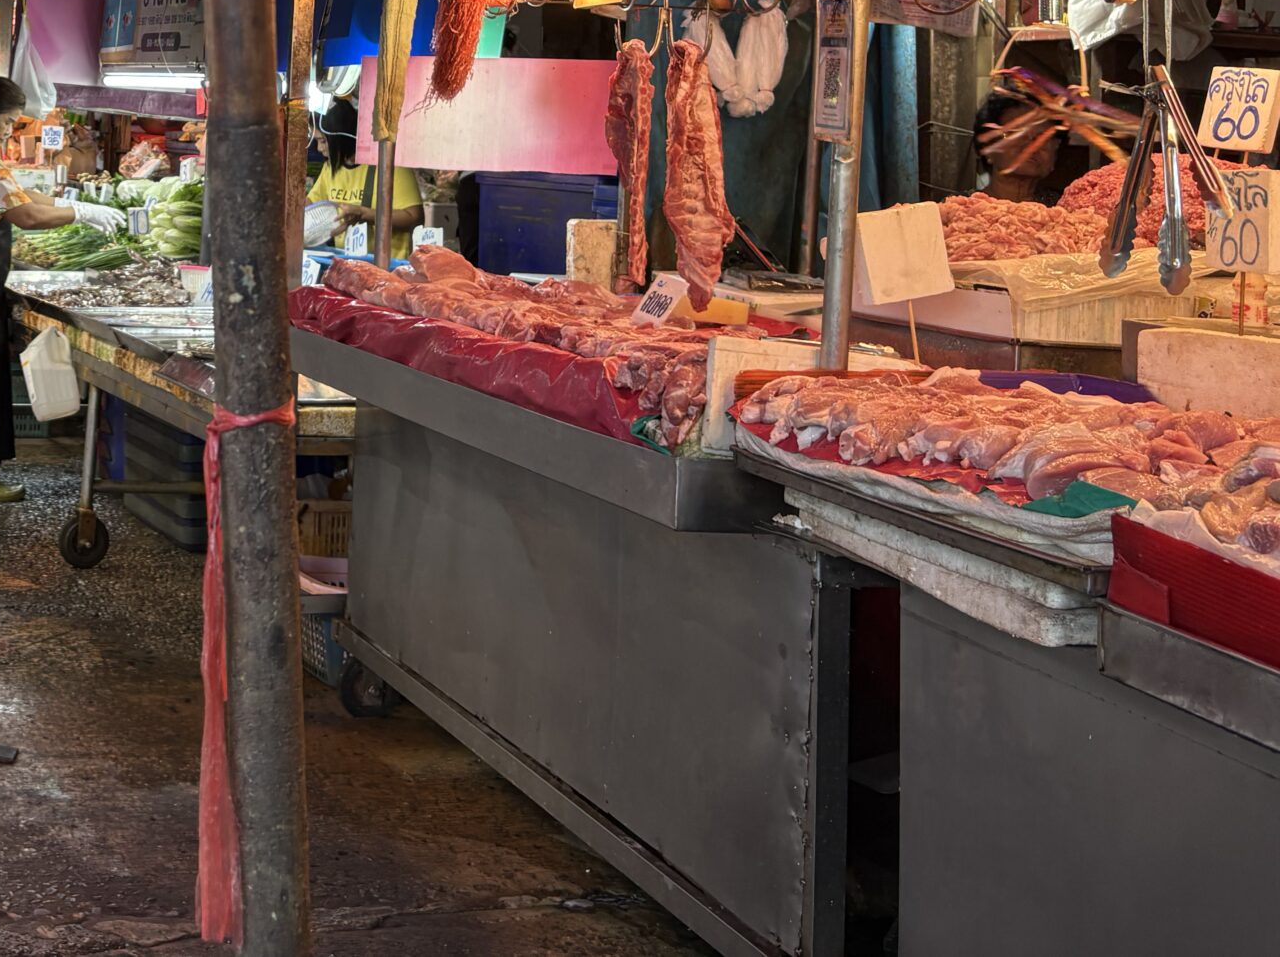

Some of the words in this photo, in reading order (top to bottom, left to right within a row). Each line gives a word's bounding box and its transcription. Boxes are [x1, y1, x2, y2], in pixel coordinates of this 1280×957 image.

[1212, 102, 1260, 142] 60
[129, 210, 150, 235] 10
[1220, 218, 1260, 267] 60
